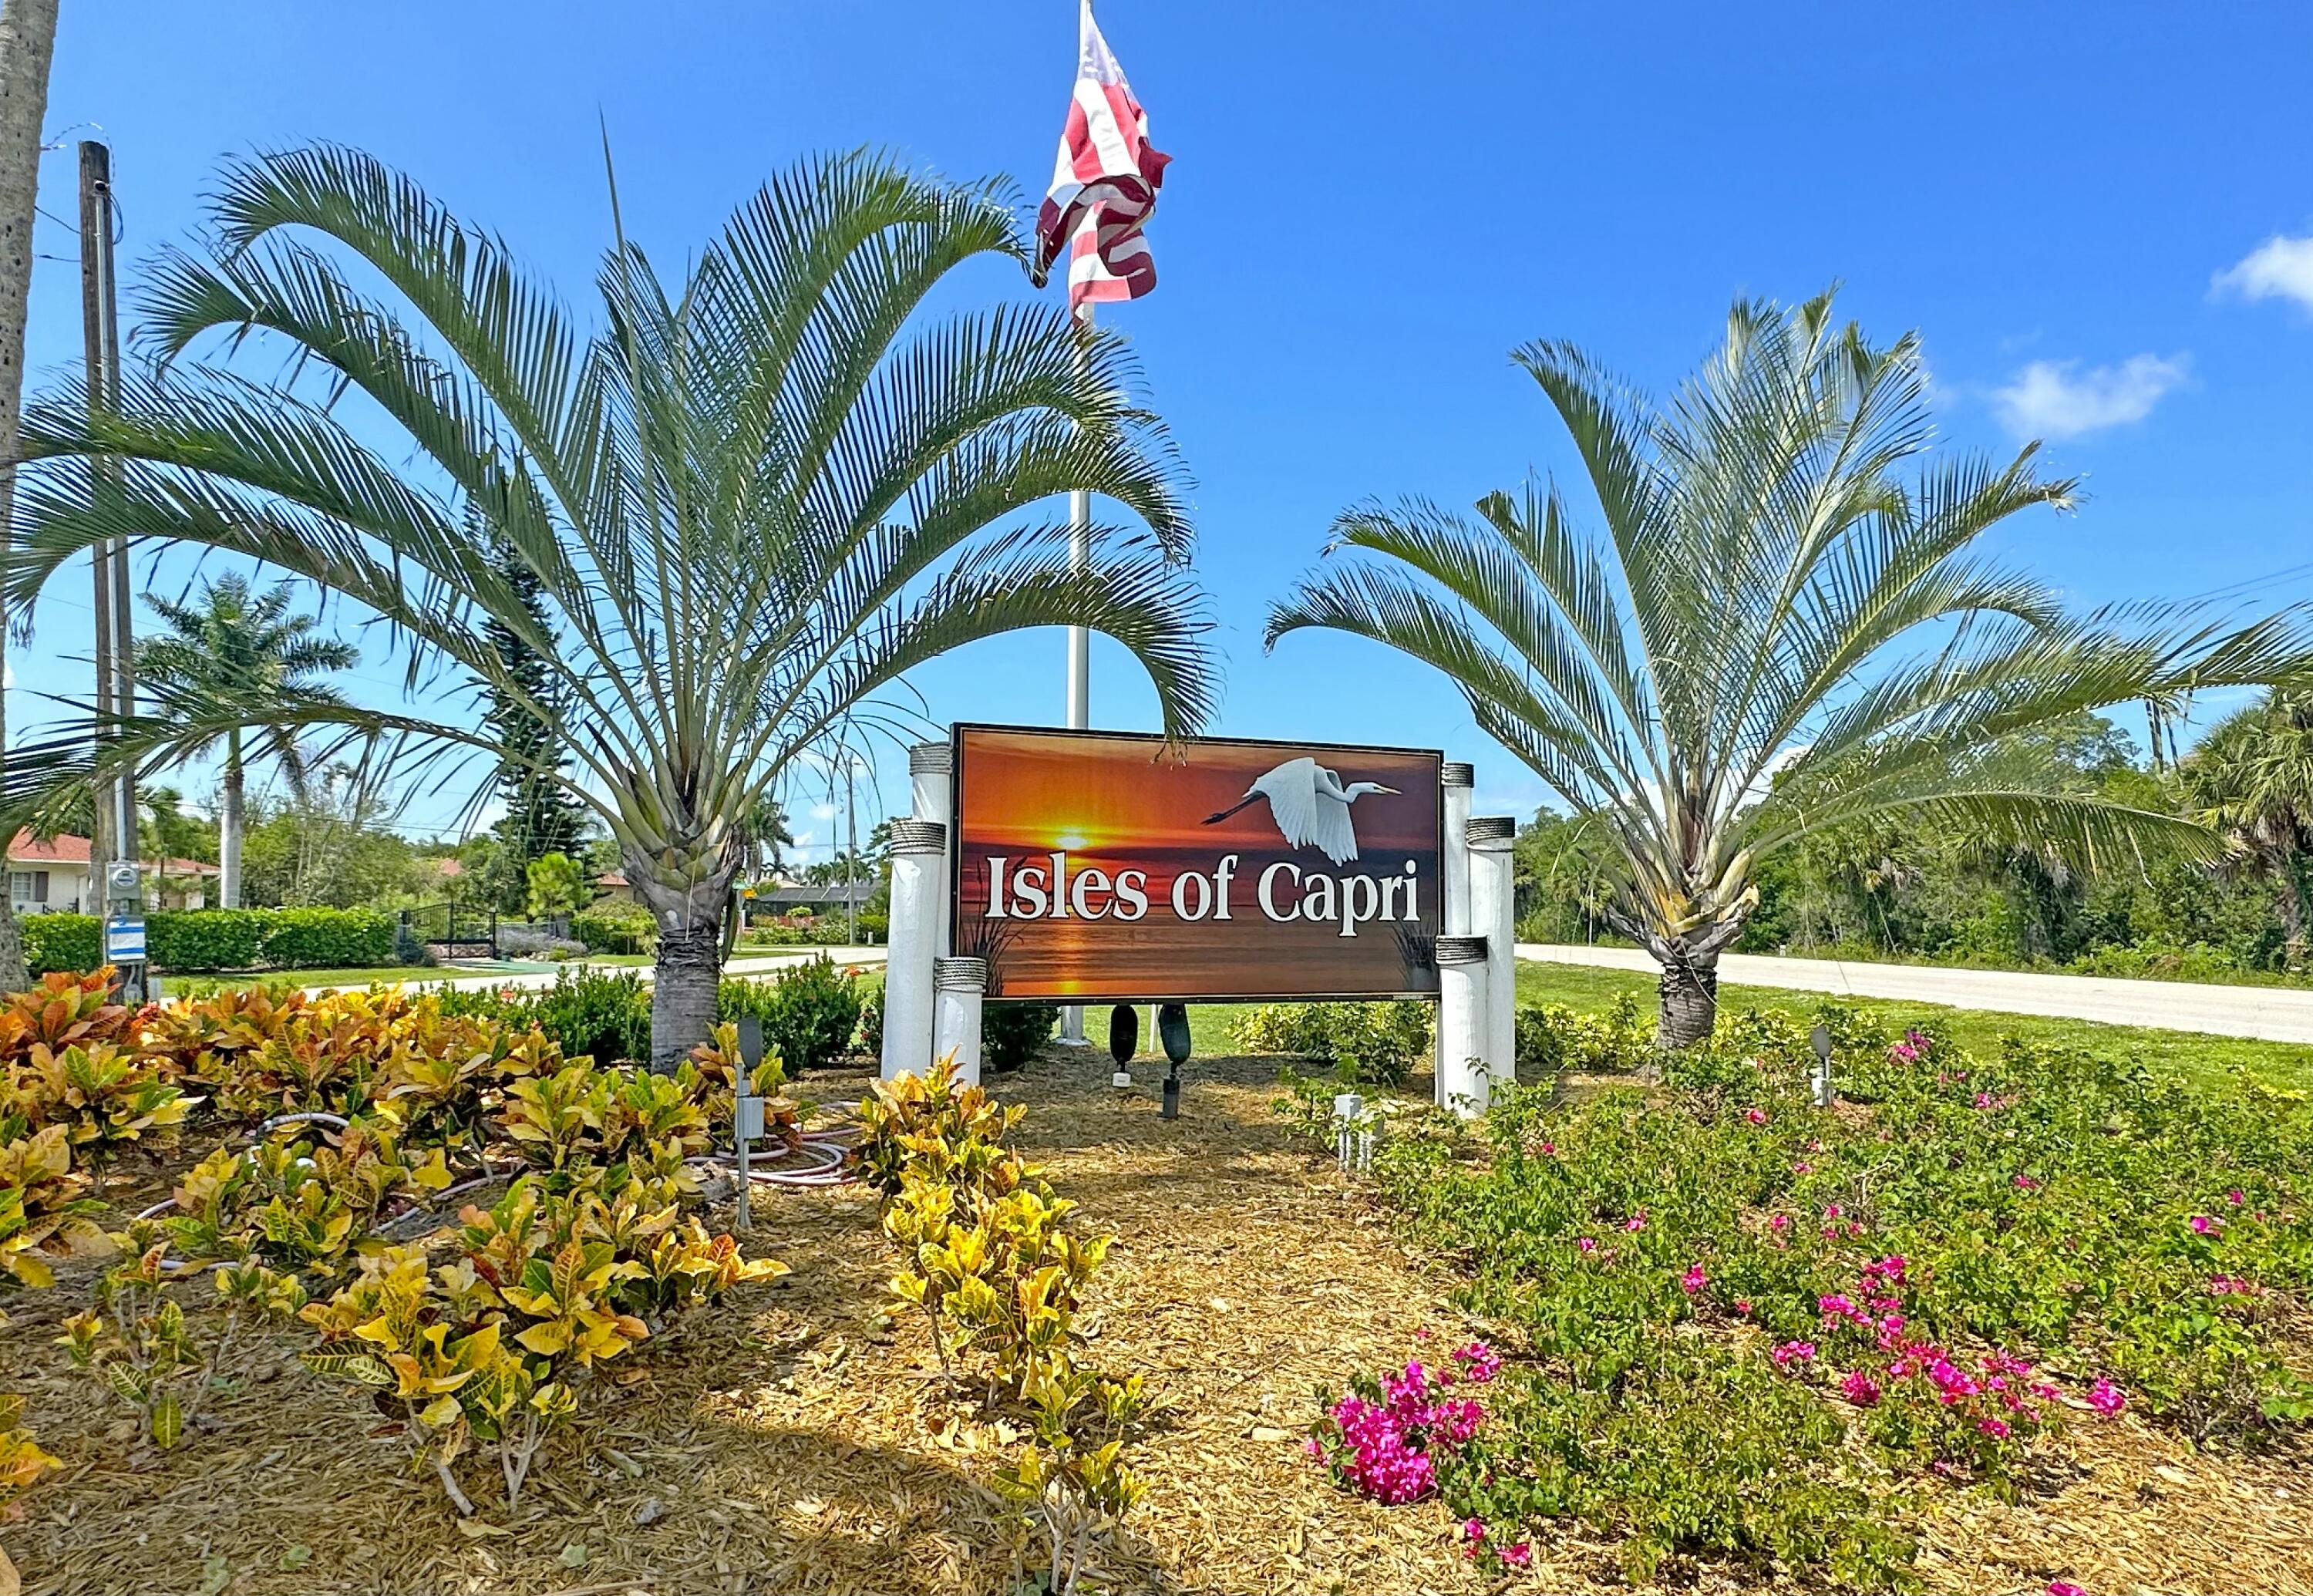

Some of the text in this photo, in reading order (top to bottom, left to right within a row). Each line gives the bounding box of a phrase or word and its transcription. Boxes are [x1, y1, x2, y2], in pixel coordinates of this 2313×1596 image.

[985, 851, 1421, 937] Isles of Capri
